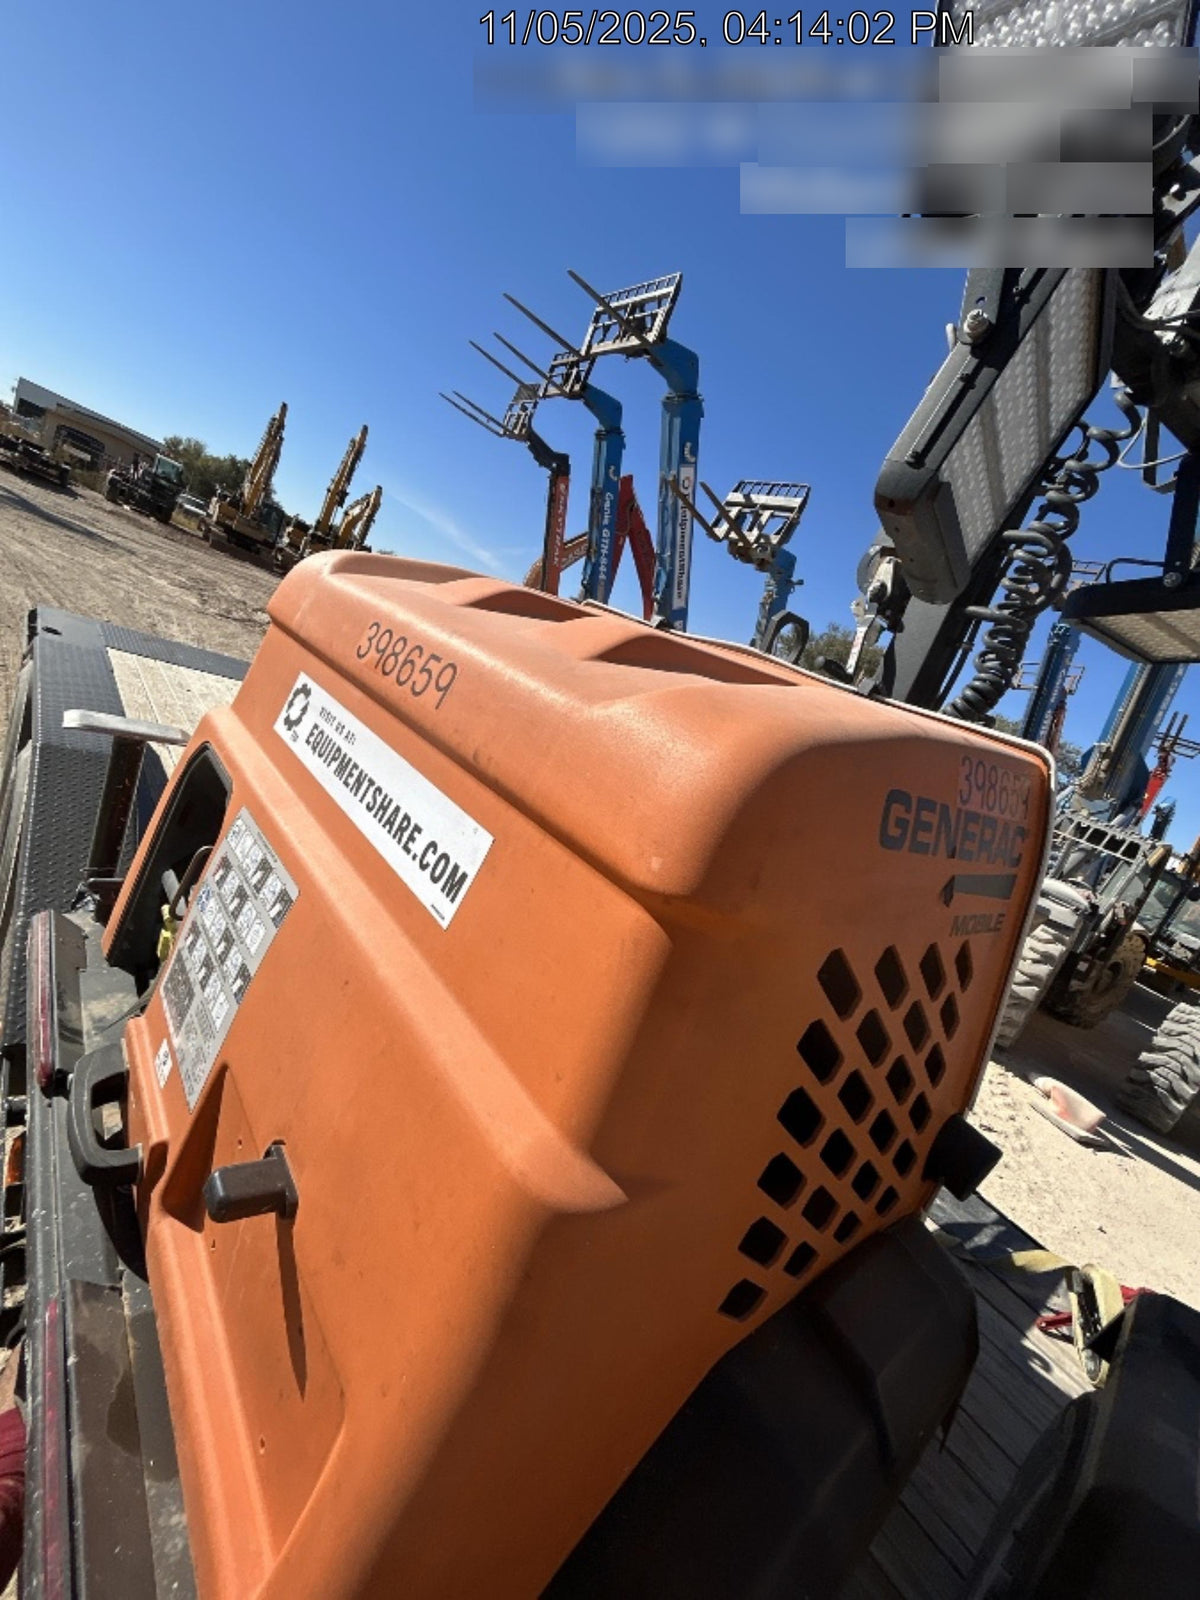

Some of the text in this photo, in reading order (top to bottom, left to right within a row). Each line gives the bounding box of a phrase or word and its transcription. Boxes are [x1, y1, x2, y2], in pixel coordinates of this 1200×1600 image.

[356, 621, 458, 710] 398659
[305, 723, 469, 904] EQUIPMENTSHARE.COM
[879, 788, 1029, 868] GENERAC
[949, 912, 1006, 938] MOBILE
